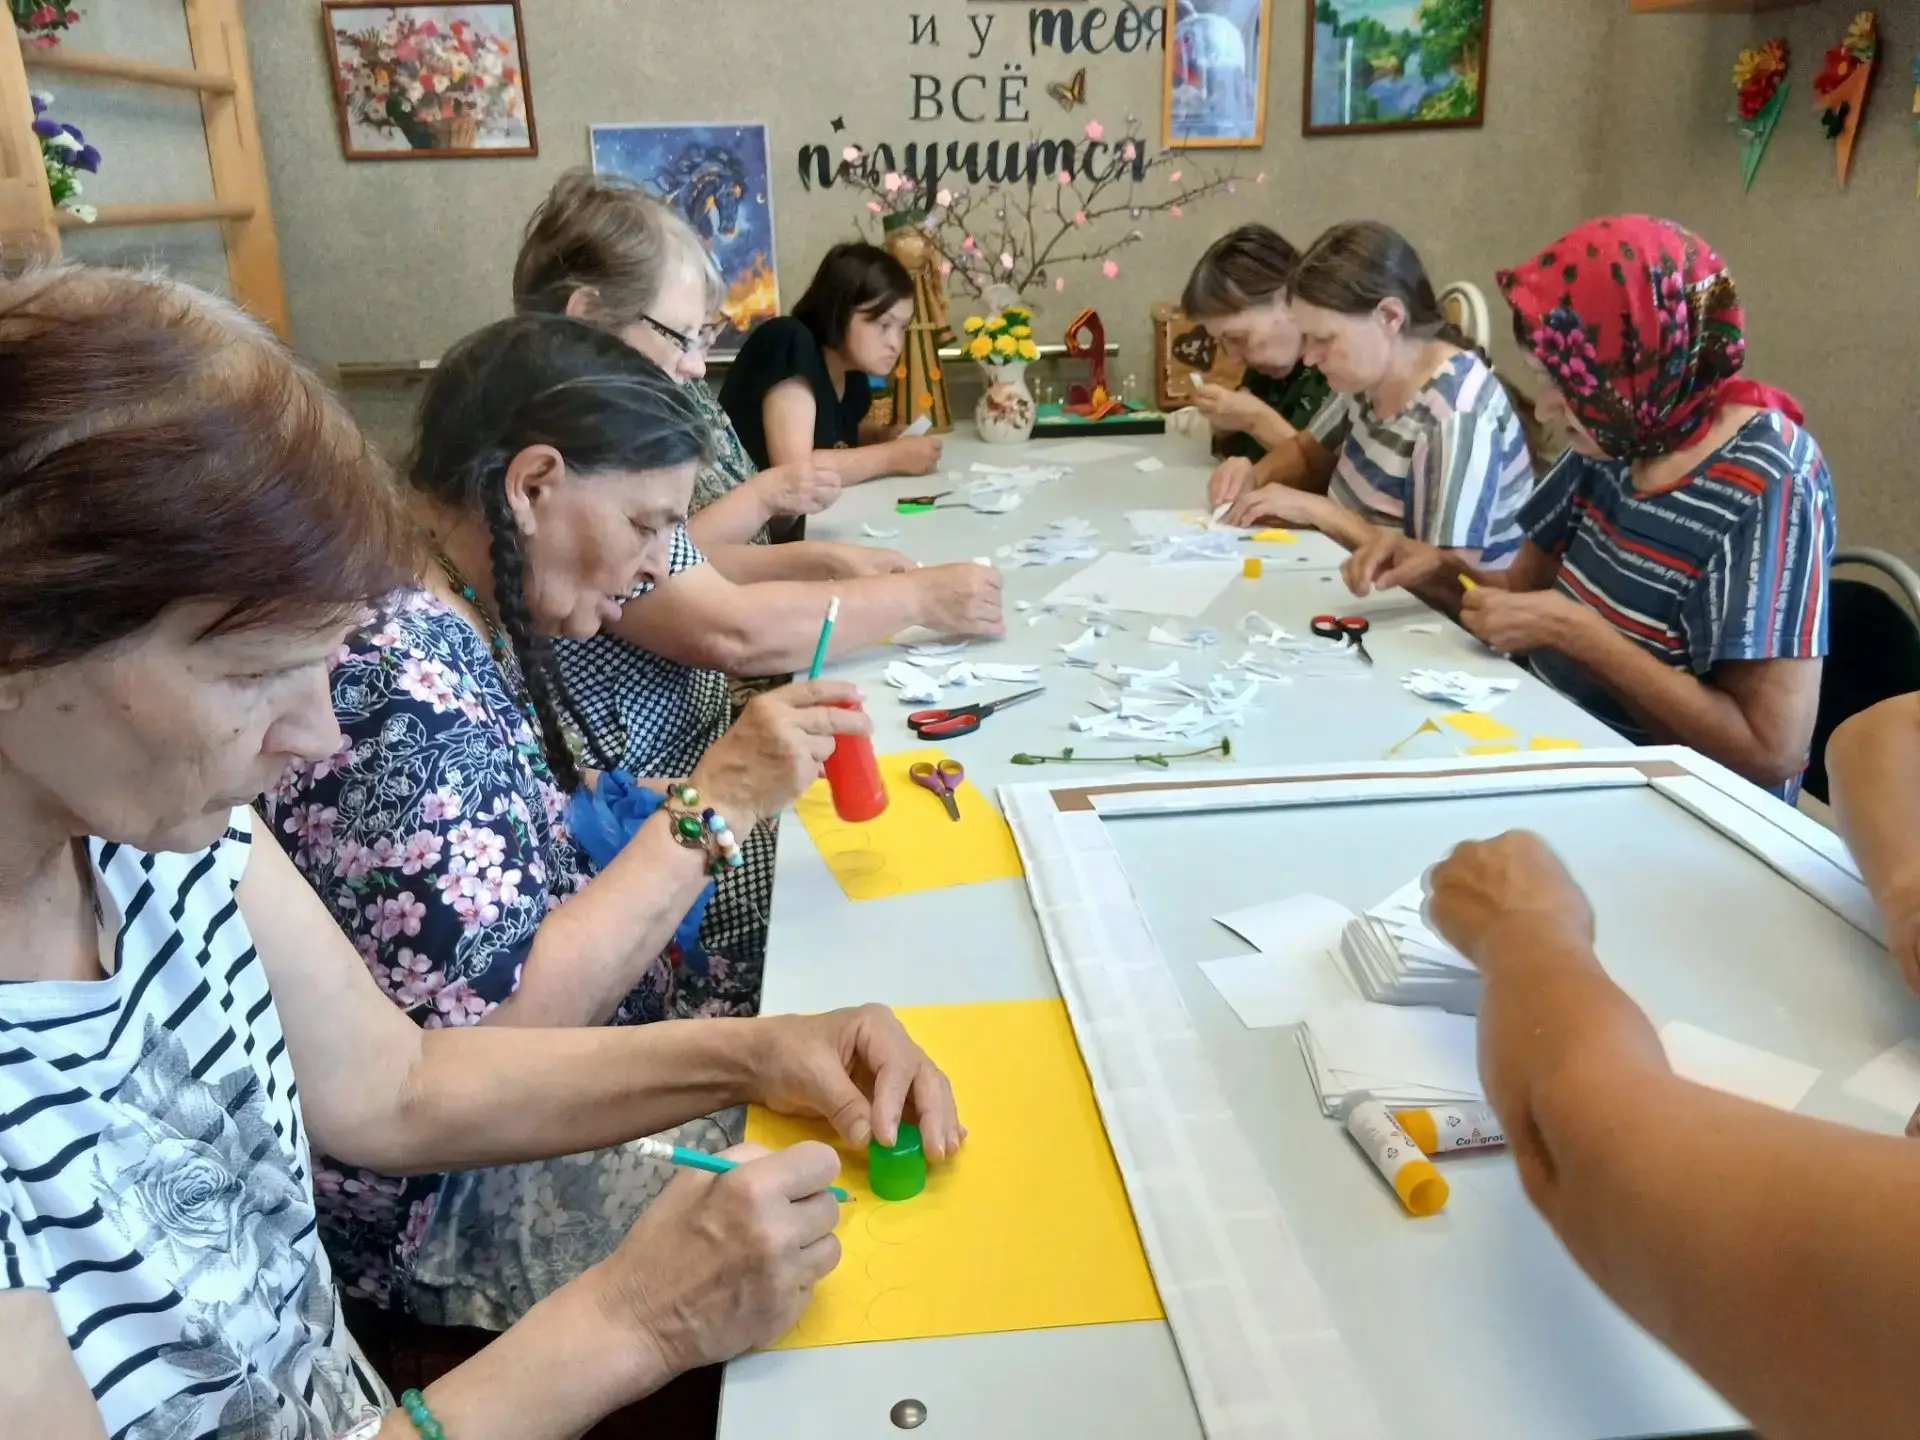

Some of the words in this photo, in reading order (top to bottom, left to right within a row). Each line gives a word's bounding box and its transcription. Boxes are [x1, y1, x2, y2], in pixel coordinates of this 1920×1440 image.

[909, 14, 939, 46] и
[967, 14, 996, 58] у
[909, 63, 1029, 123] ВСЁ
